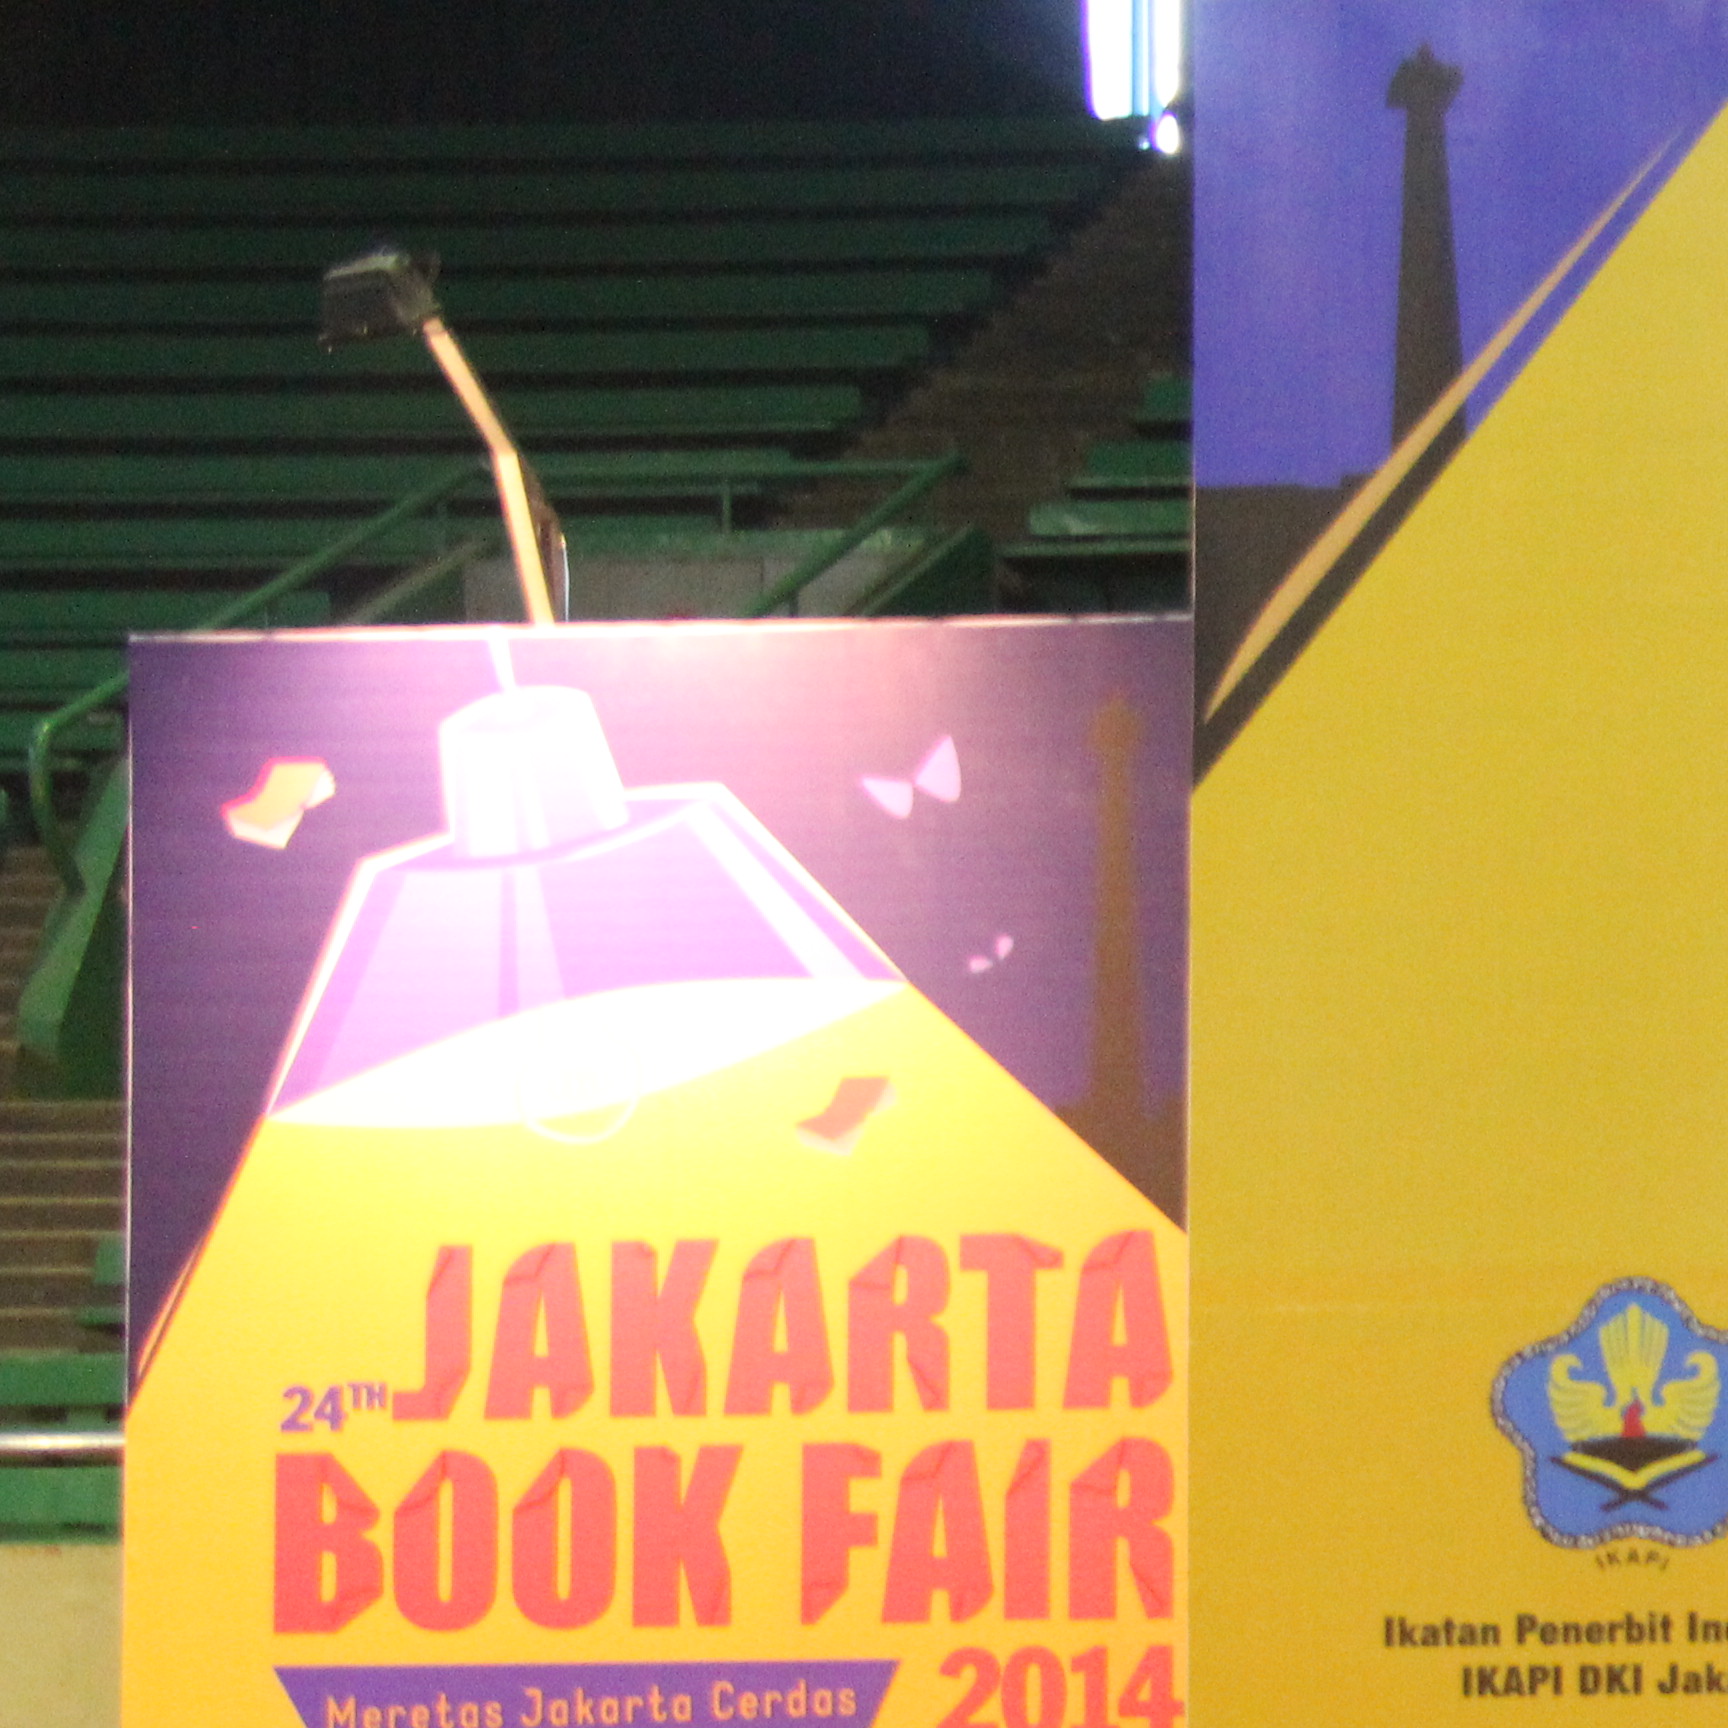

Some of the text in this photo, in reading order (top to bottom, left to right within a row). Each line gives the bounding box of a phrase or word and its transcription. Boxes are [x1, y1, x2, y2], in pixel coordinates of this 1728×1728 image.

[280, 1229, 1175, 1433] 24TH JAKARTA
[272, 1436, 1175, 1633] BOOK FAIR
[1383, 1616, 1501, 1647] Ikatan
[1515, 1613, 1673, 1645] Penerbit
[711, 1680, 857, 1721] Cerdas
[1462, 1665, 1562, 1697] IKAPI
[1578, 1664, 1643, 1695] DKI
